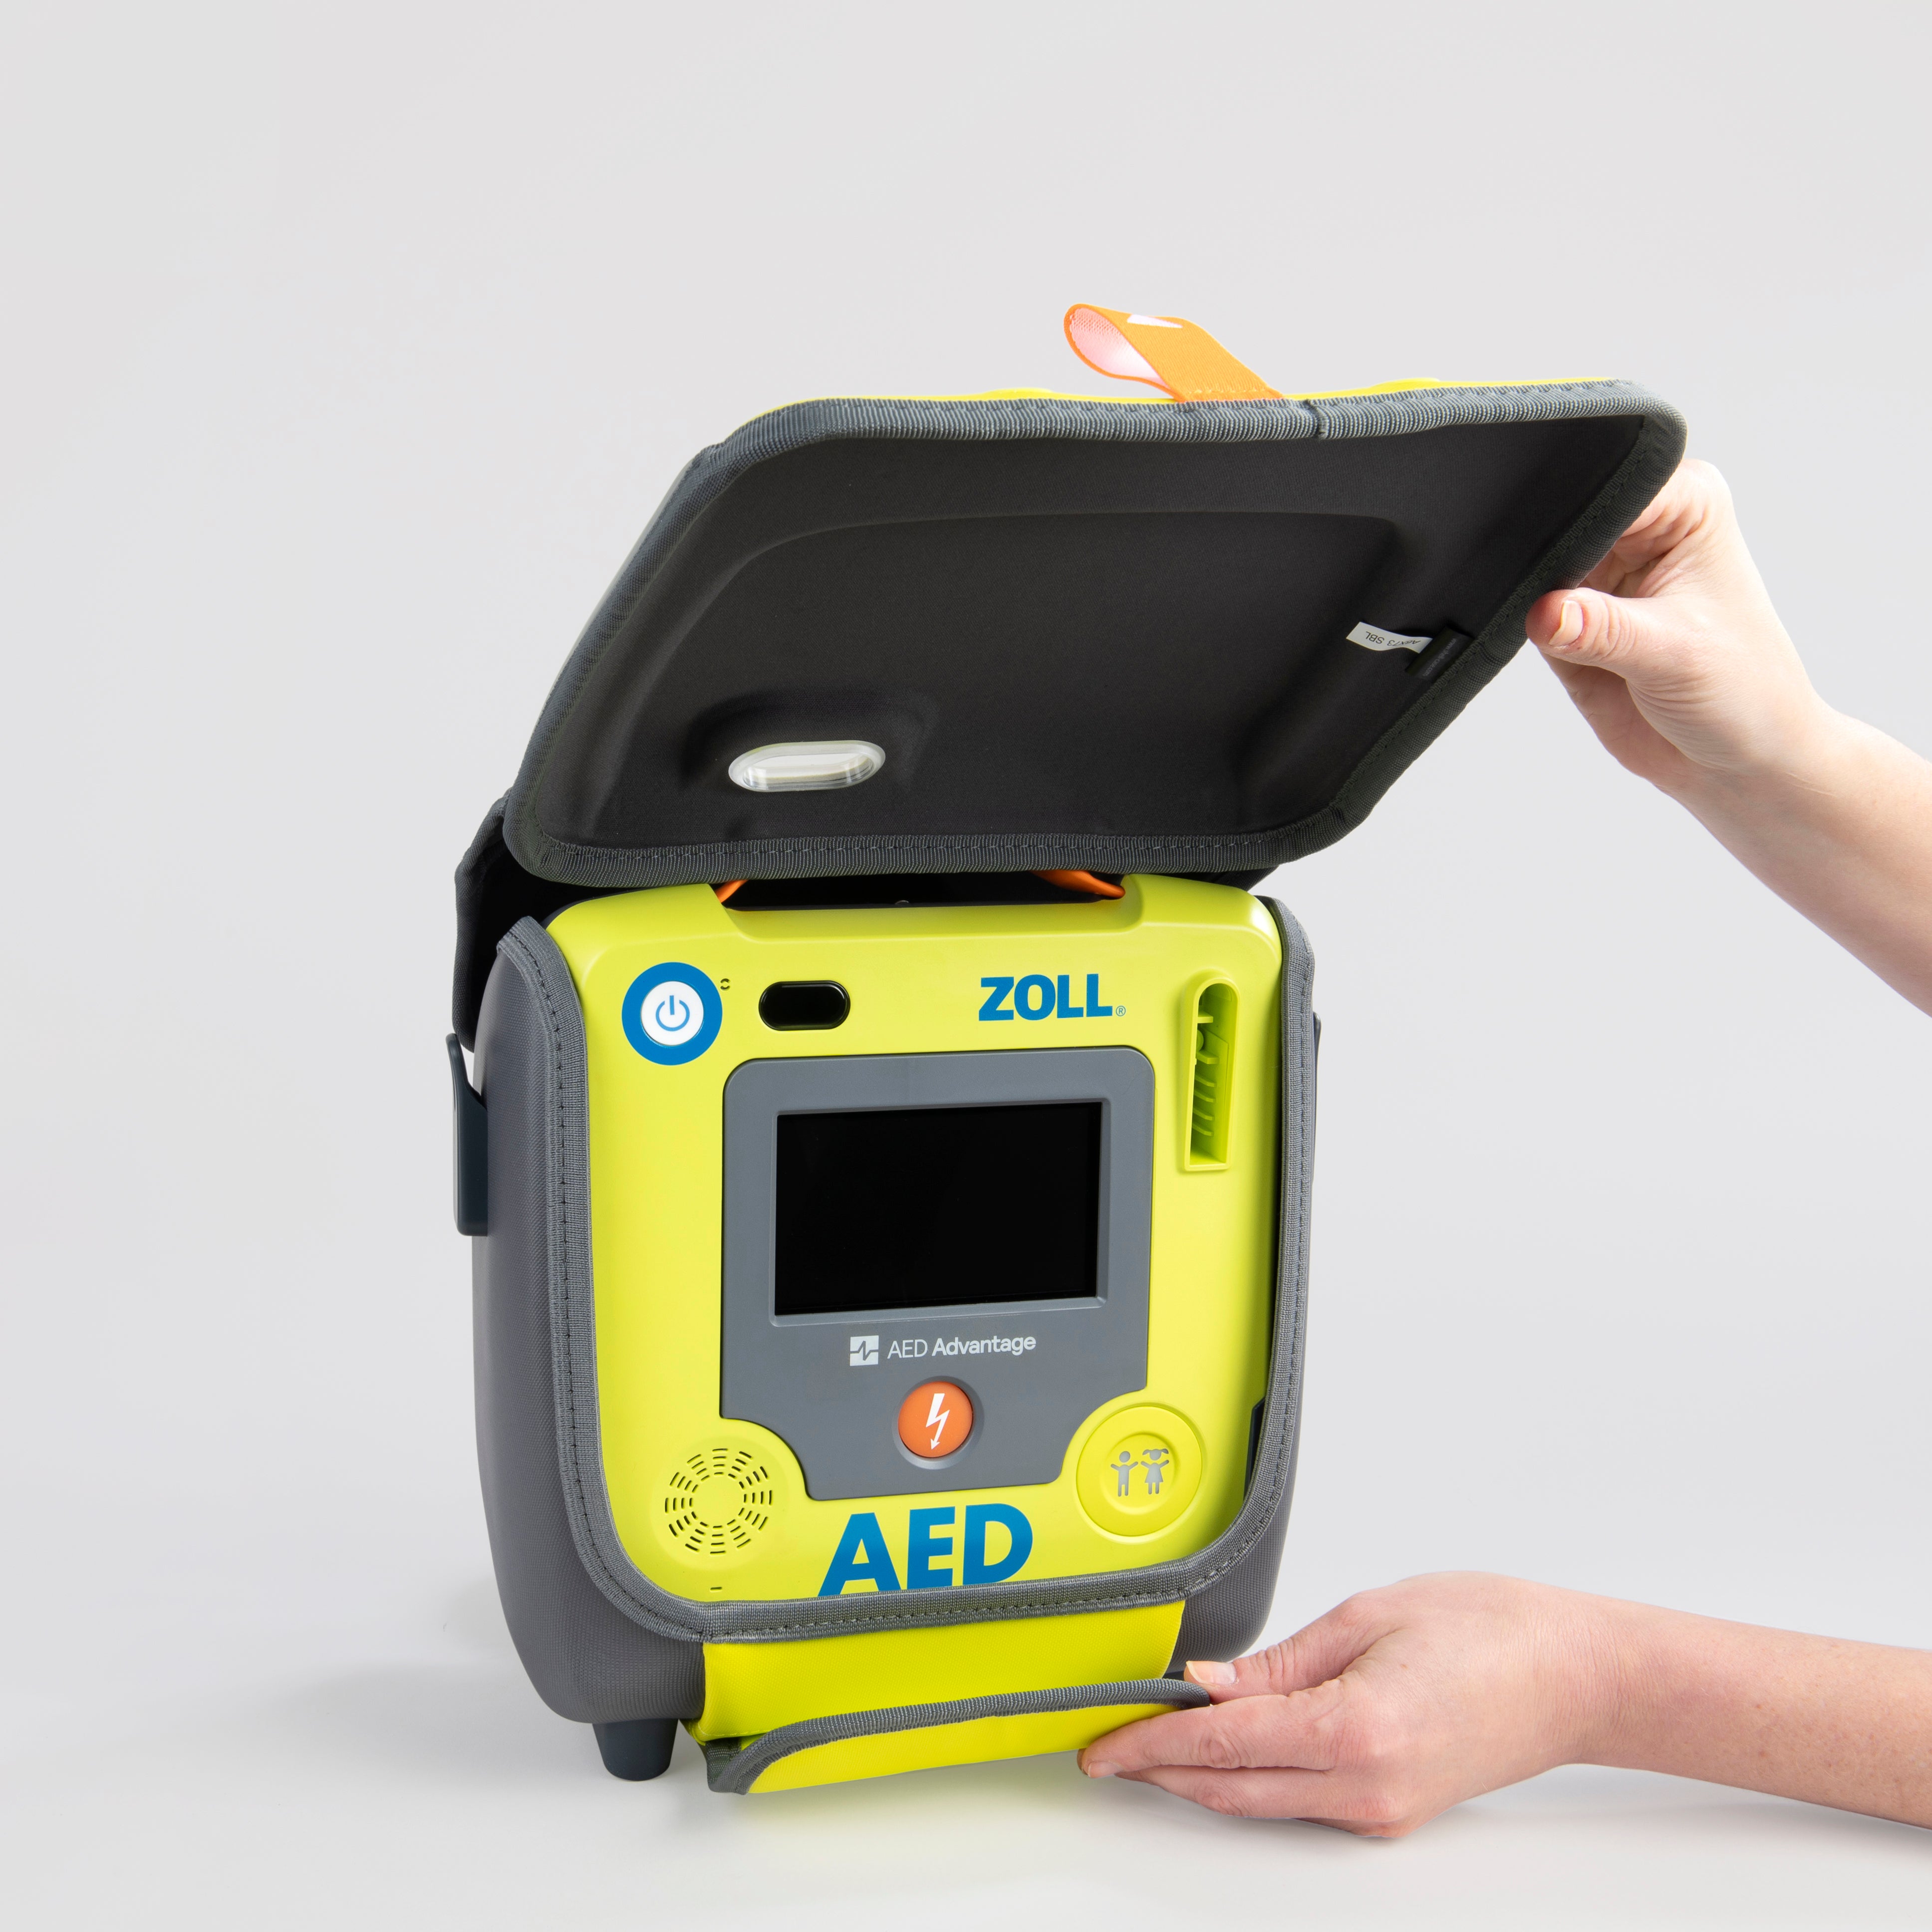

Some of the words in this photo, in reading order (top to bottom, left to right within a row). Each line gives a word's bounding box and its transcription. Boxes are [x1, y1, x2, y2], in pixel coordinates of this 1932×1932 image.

[1366, 630, 1384, 644] SBL
[887, 1339, 928, 1359] AED
[931, 1335, 1037, 1356] Advantage
[818, 1503, 1033, 1597] AED
